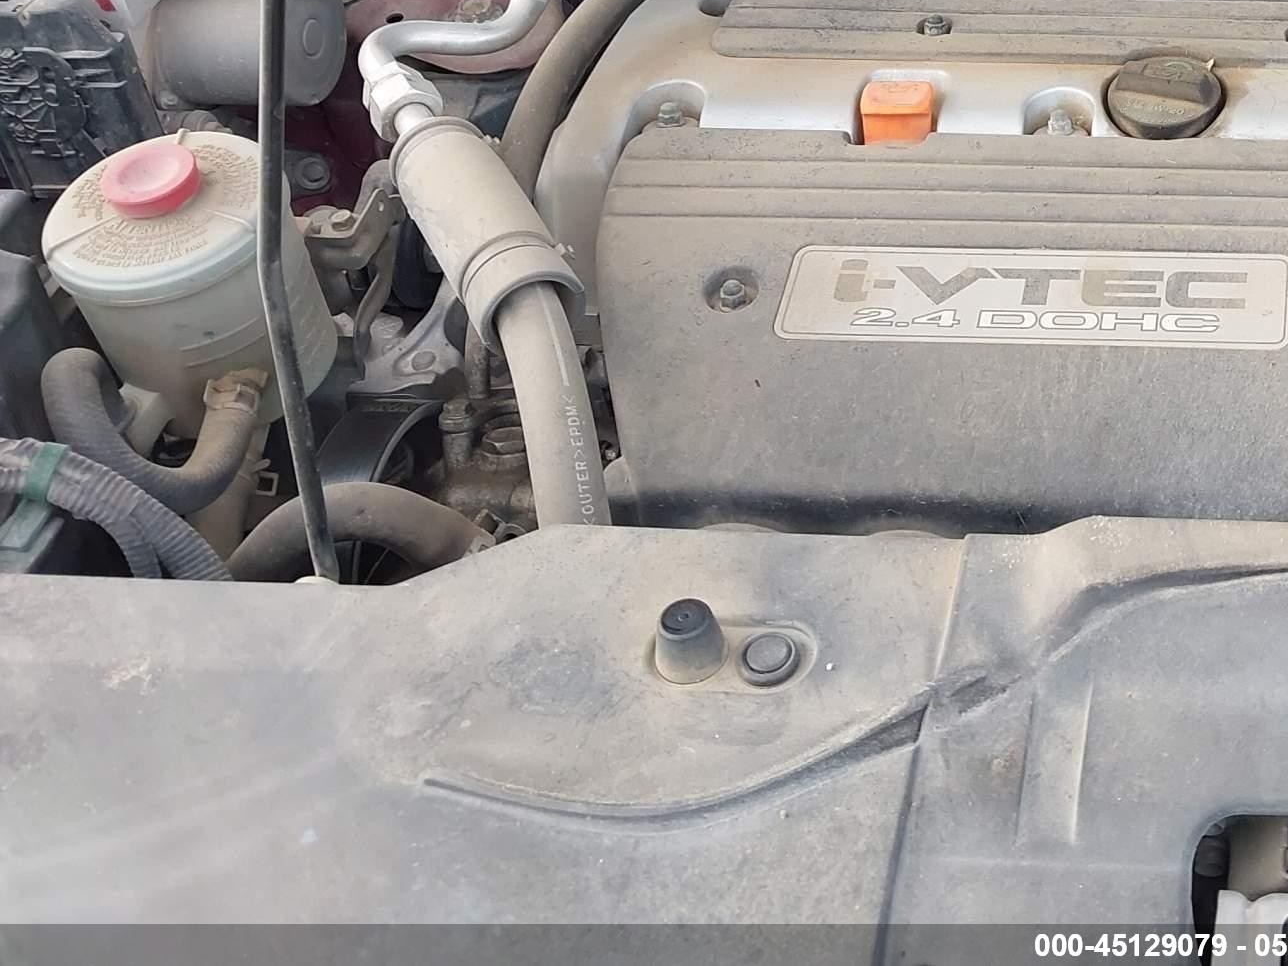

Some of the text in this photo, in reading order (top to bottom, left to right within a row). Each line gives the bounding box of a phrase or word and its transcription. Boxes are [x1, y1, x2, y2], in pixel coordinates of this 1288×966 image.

[834, 259, 1248, 309] i-VTEC
[850, 307, 1220, 333] 2.4 DOHC
